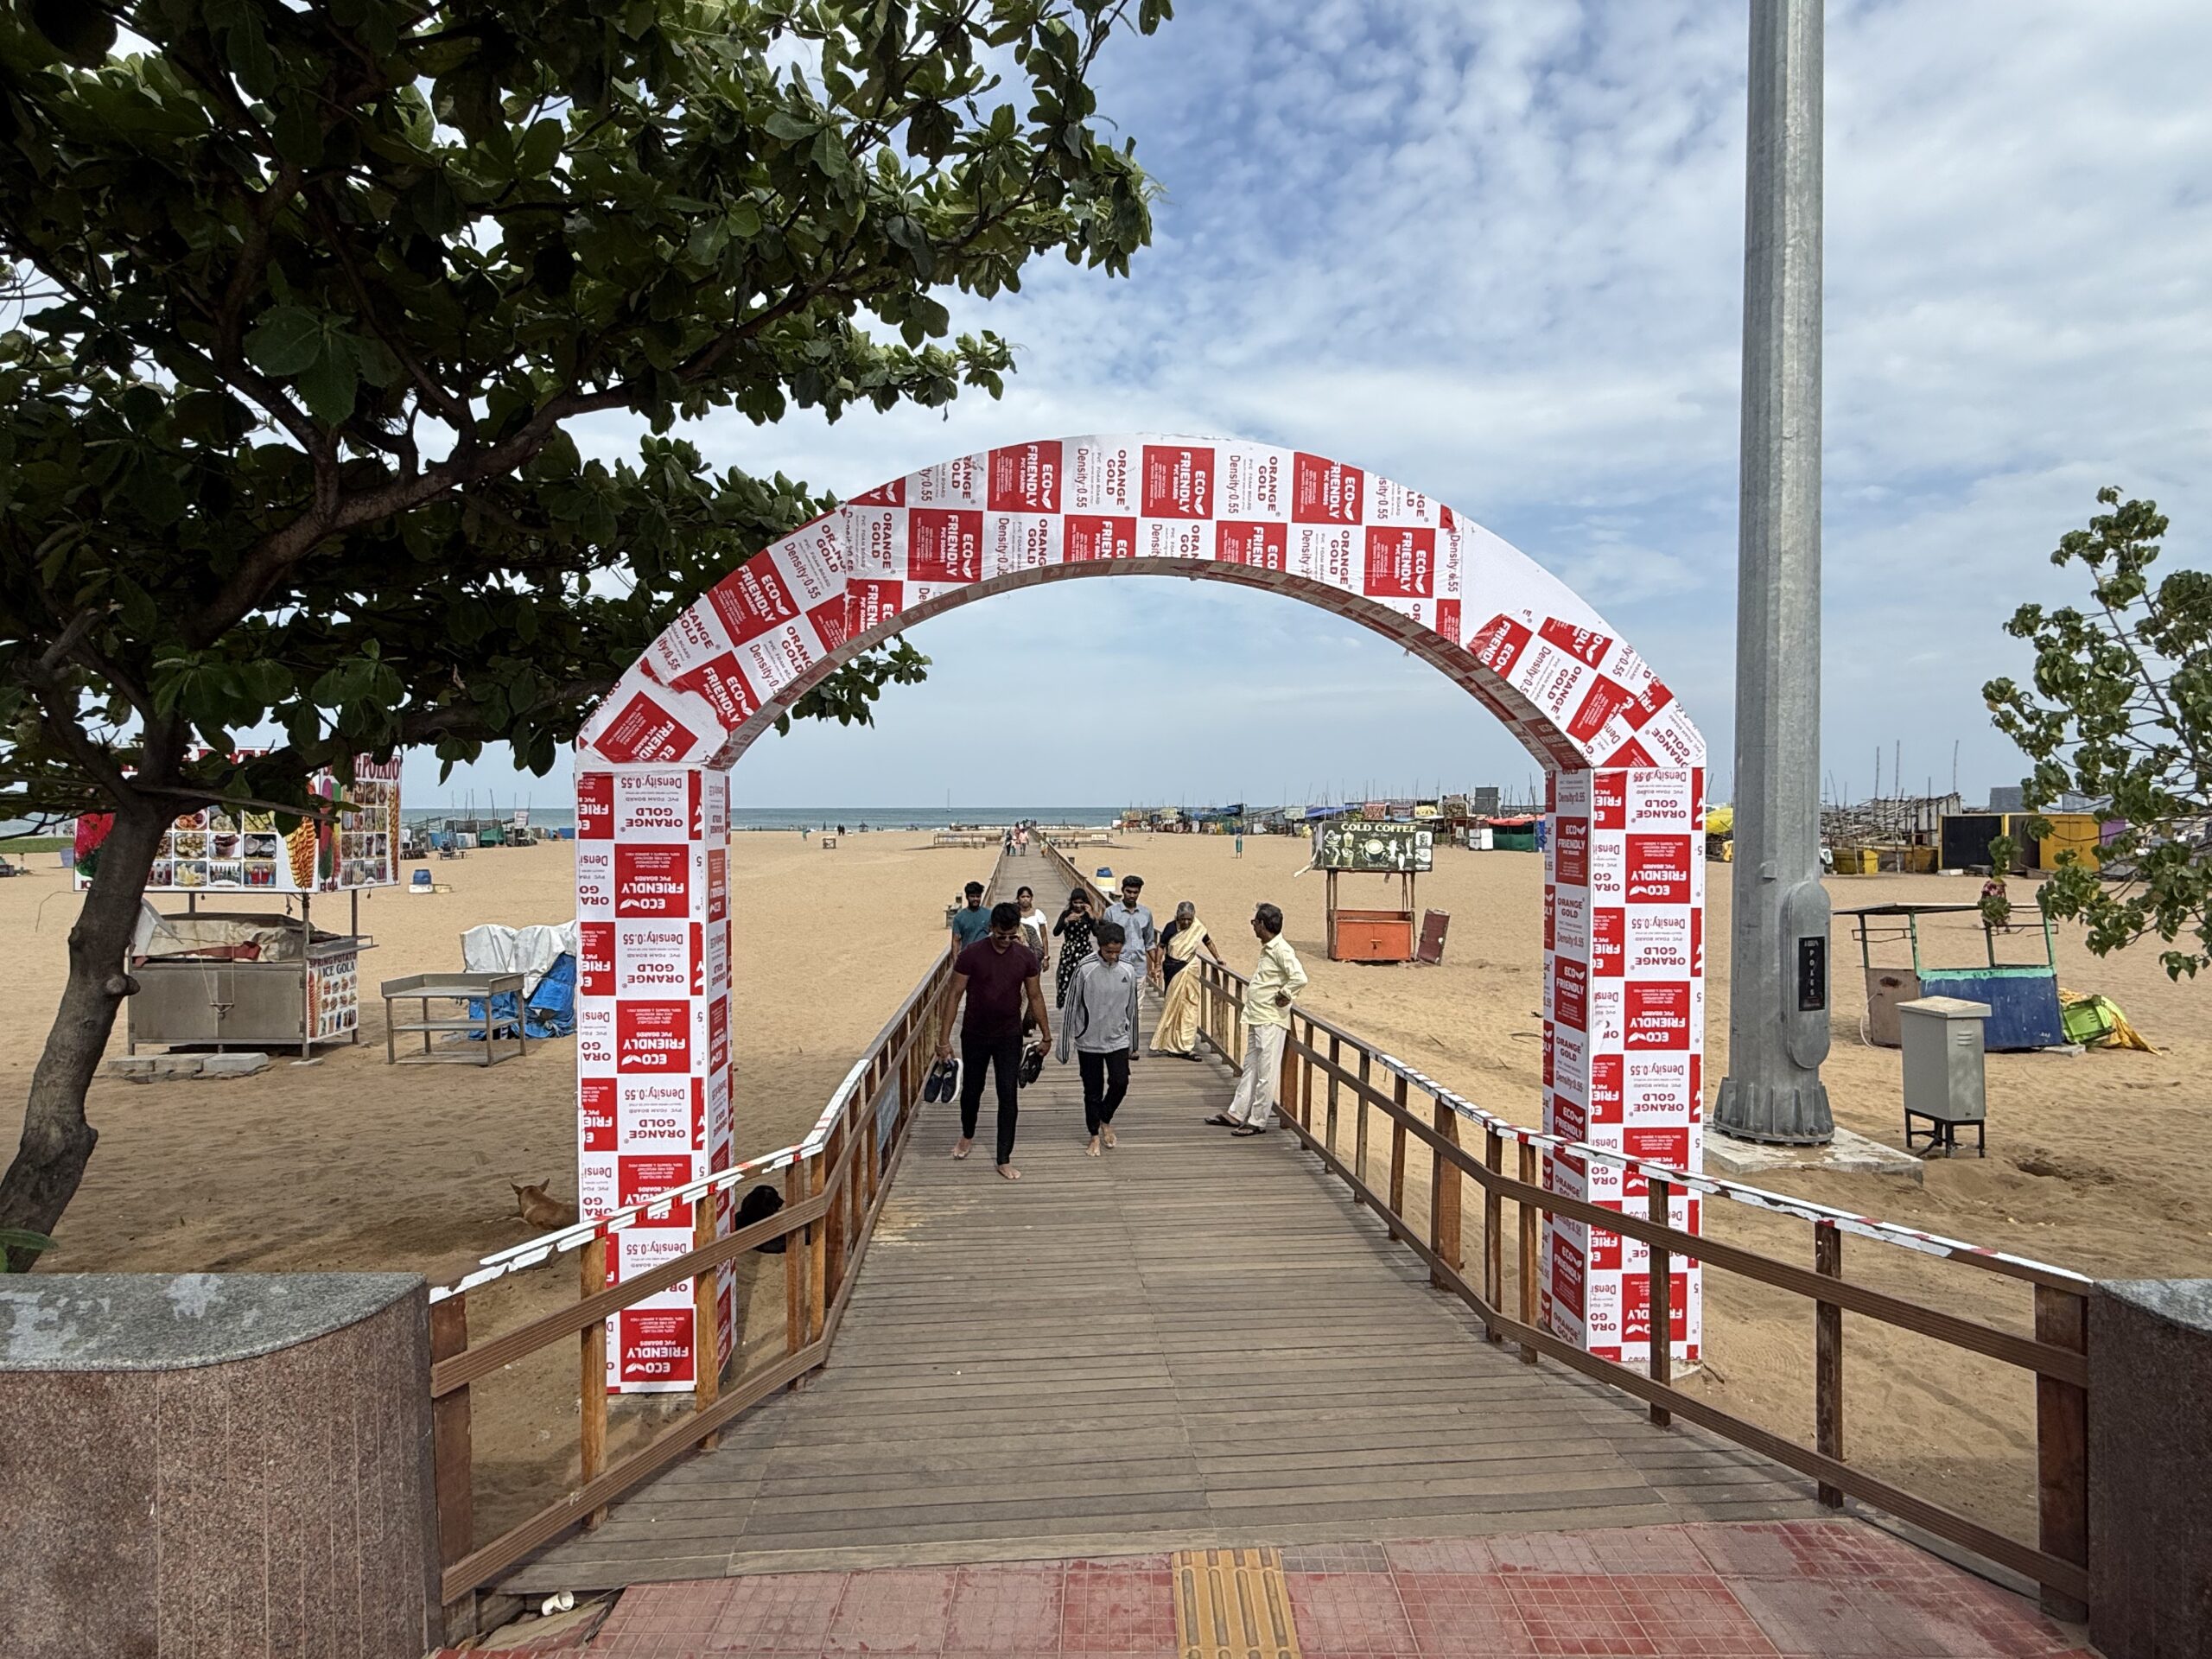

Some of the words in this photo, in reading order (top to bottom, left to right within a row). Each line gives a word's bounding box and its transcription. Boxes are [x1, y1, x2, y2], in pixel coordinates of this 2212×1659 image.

[1026, 444, 1038, 506] FRIENDLY
[1041, 464, 1053, 489] ECO
[1074, 448, 1089, 509] Density:0.55
[1106, 459, 1116, 495] GOLD
[1116, 449, 1127, 505] ORANGE
[1179, 452, 1191, 513] FRIENDLY
[1194, 470, 1205, 495] ECO
[1226, 455, 1241, 513] Density:0.55
[1258, 466, 1267, 502] GOLD
[1268, 456, 1278, 512] ORANGE
[1344, 476, 1356, 501] ECO
[871, 521, 881, 559] GOLD
[882, 512, 892, 569] ORANGE
[946, 514, 959, 577] FRIENDLY
[963, 534, 974, 559] ECO
[1027, 528, 1036, 564] GOLD
[817, 538, 838, 574] GOLD
[1329, 540, 1339, 575] GOLD
[1340, 530, 1350, 586] ORANGE
[1400, 531, 1413, 592] FRIENDLY
[1415, 550, 1427, 575] ECO
[784, 542, 821, 600] Density:0.55
[738, 565, 776, 623] FRIENDLY
[760, 575, 780, 600] ECO
[1497, 643, 1515, 666] ECO
[726, 677, 745, 703] ECO
[1547, 668, 1569, 700] GOLD
[1550, 665, 1582, 714] ORANGE
[702, 666, 741, 723] FRIENDLY
[1665, 728, 1690, 757] GOLD
[621, 775, 682, 789] Density:0.55
[1645, 799, 1677, 808] GOLD
[1636, 810, 1687, 818] ORANGE
[1566, 825, 1577, 835] ECO
[1631, 871, 1687, 880] FRIENDLY
[621, 882, 684, 893] FRIENDLY
[1595, 883, 1620, 892] ORA
[1648, 885, 1670, 895] ECO
[640, 899, 665, 909] ECO
[1558, 897, 1583, 909] ORANGE
[1561, 909, 1578, 918] GOLD
[1631, 916, 1685, 929] Density:0.55
[623, 931, 683, 945] Density:0.55
[309, 956, 333, 969] SPRING
[334, 952, 357, 964] POTATO
[638, 963, 674, 972] GOLD
[323, 966, 334, 977] ICE
[336, 961, 355, 975] GOLA
[1564, 966, 1576, 978] ECO
[627, 975, 684, 983] ORANGE
[1630, 1018, 1686, 1028] FRIENDLY
[1646, 1032, 1669, 1042] ECO
[581, 1041, 601, 1050] GO
[623, 1039, 685, 1050] FRIENDLY
[1556, 1037, 1581, 1053] ORANGE
[583, 1052, 611, 1061] ORA
[642, 1054, 667, 1065] ECO
[1560, 1049, 1577, 1062] GOLD
[1630, 1063, 1684, 1076] Density:0.55
[625, 1087, 685, 1100] Density:0.55
[1562, 1107, 1574, 1121] ECO
[1633, 1103, 1684, 1112] ORANGE
[639, 1119, 676, 1128] GOLD
[629, 1130, 686, 1139] ORANGE
[1592, 1166, 1609, 1175] GO
[1592, 1177, 1618, 1185] ORA
[583, 1197, 603, 1205] GO
[626, 1241, 687, 1255] Density:0.55
[626, 1346, 689, 1358] FRIENDLY
[645, 1363, 671, 1373] ECO
